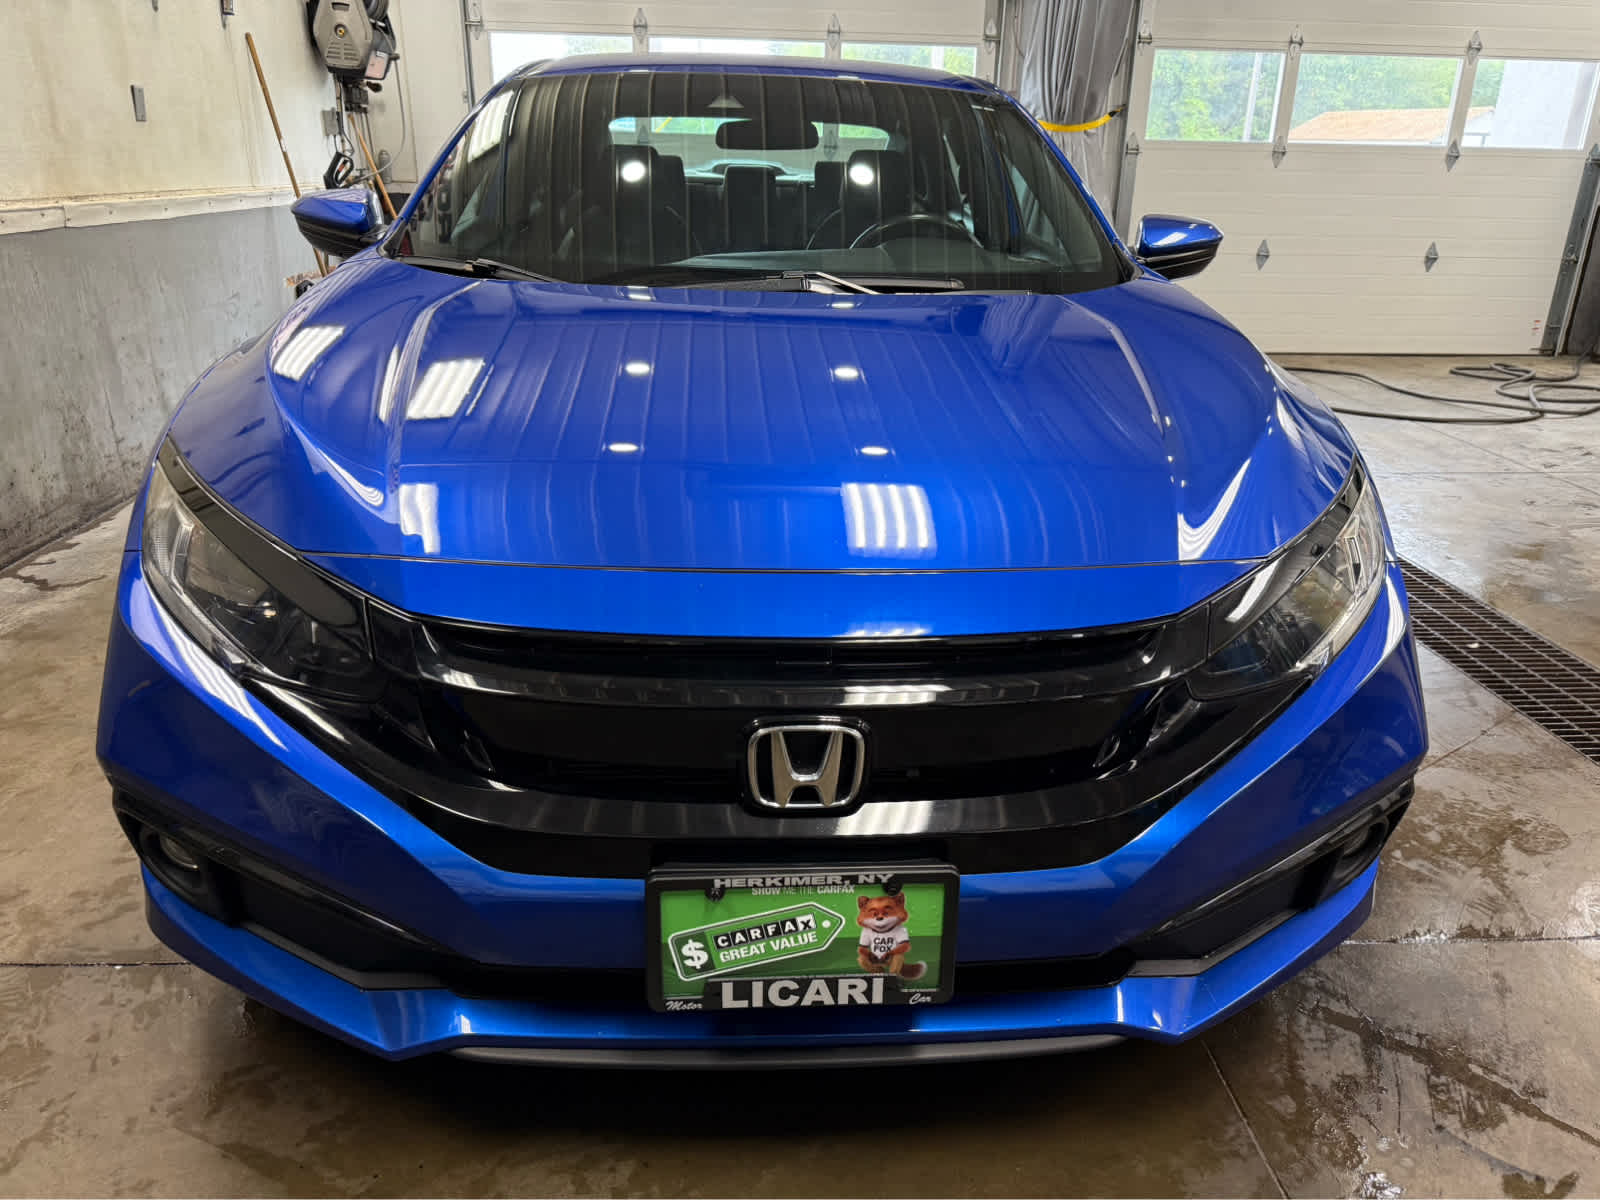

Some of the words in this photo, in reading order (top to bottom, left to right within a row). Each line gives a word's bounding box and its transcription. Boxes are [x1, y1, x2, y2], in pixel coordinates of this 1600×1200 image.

[714, 875, 851, 889] HERKIMER,
[857, 873, 895, 884] NY
[751, 886, 780, 896] SHOW
[816, 884, 855, 895] CARFAX
[714, 913, 817, 949] CARFAX
[719, 943, 767, 963] GREAT
[769, 931, 818, 951] VALUE
[873, 936, 894, 946] CAR
[873, 945, 892, 953] FOX
[665, 1000, 703, 1012] Motor
[721, 977, 884, 1009] LICARI
[908, 992, 932, 1005] Car
